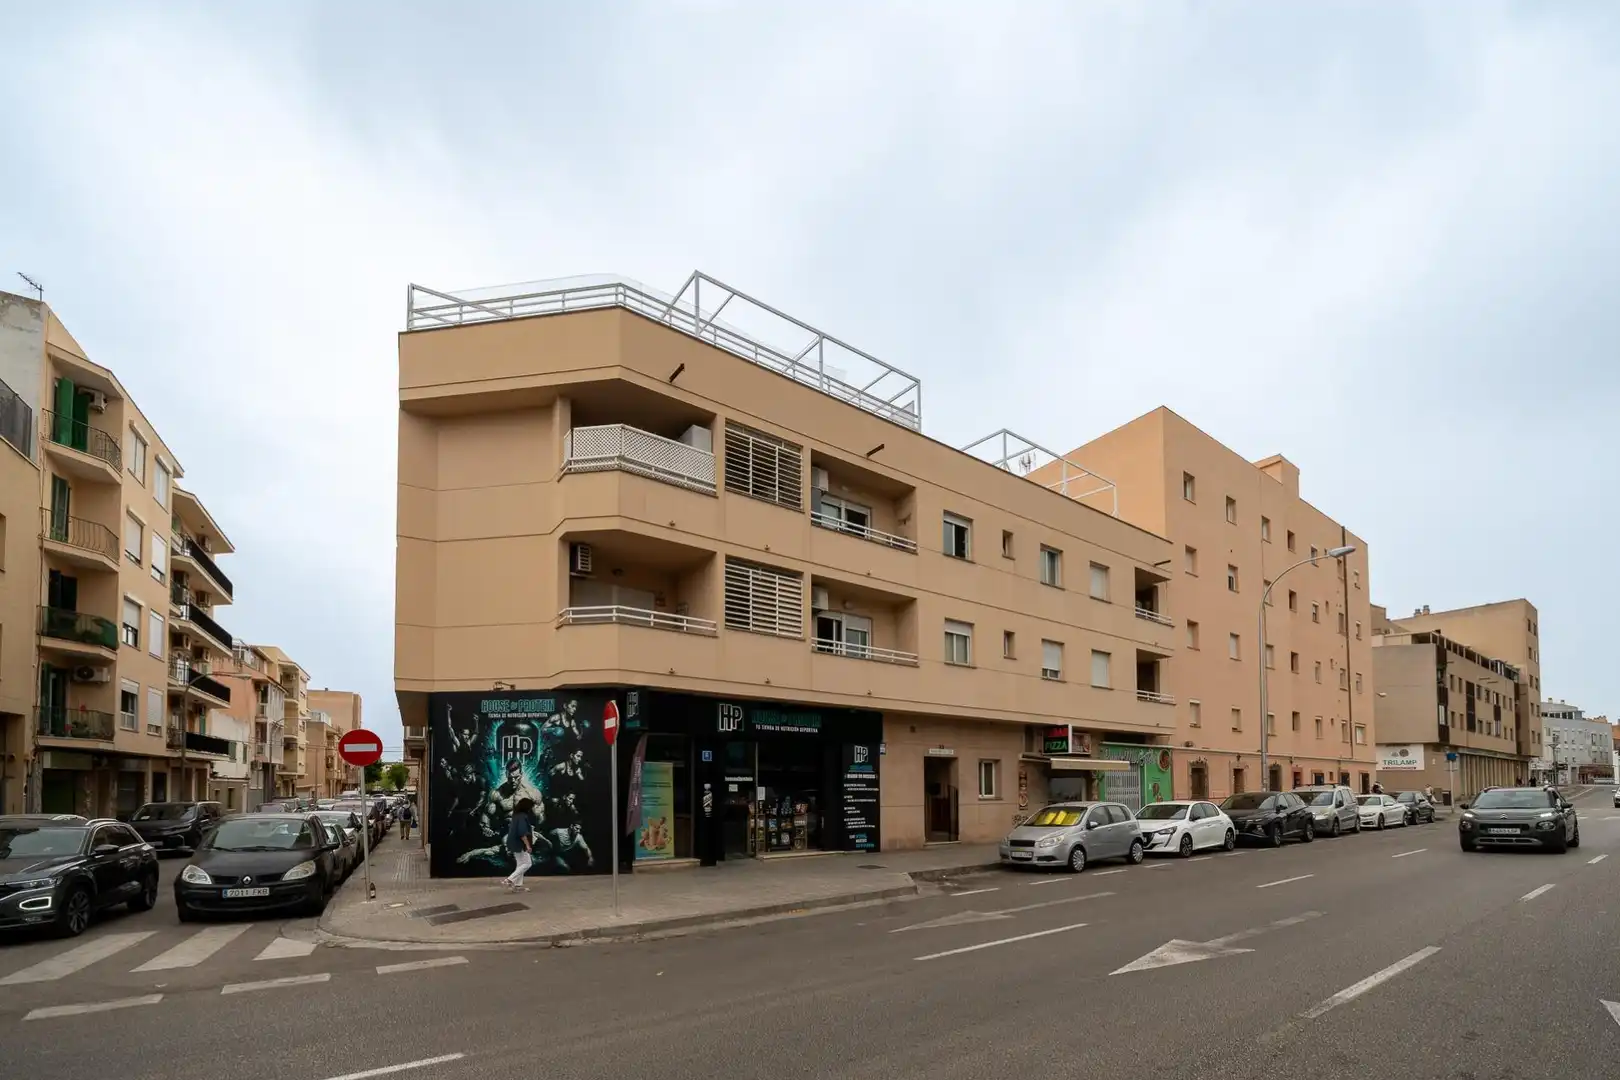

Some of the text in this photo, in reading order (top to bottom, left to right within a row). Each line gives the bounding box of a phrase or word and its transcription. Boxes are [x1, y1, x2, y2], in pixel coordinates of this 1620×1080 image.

[481, 700, 510, 713] HOUSE
[718, 703, 743, 732] HP
[502, 735, 533, 768] HP
[854, 745, 869, 763] HP
[1045, 740, 1068, 751] PIZZA
